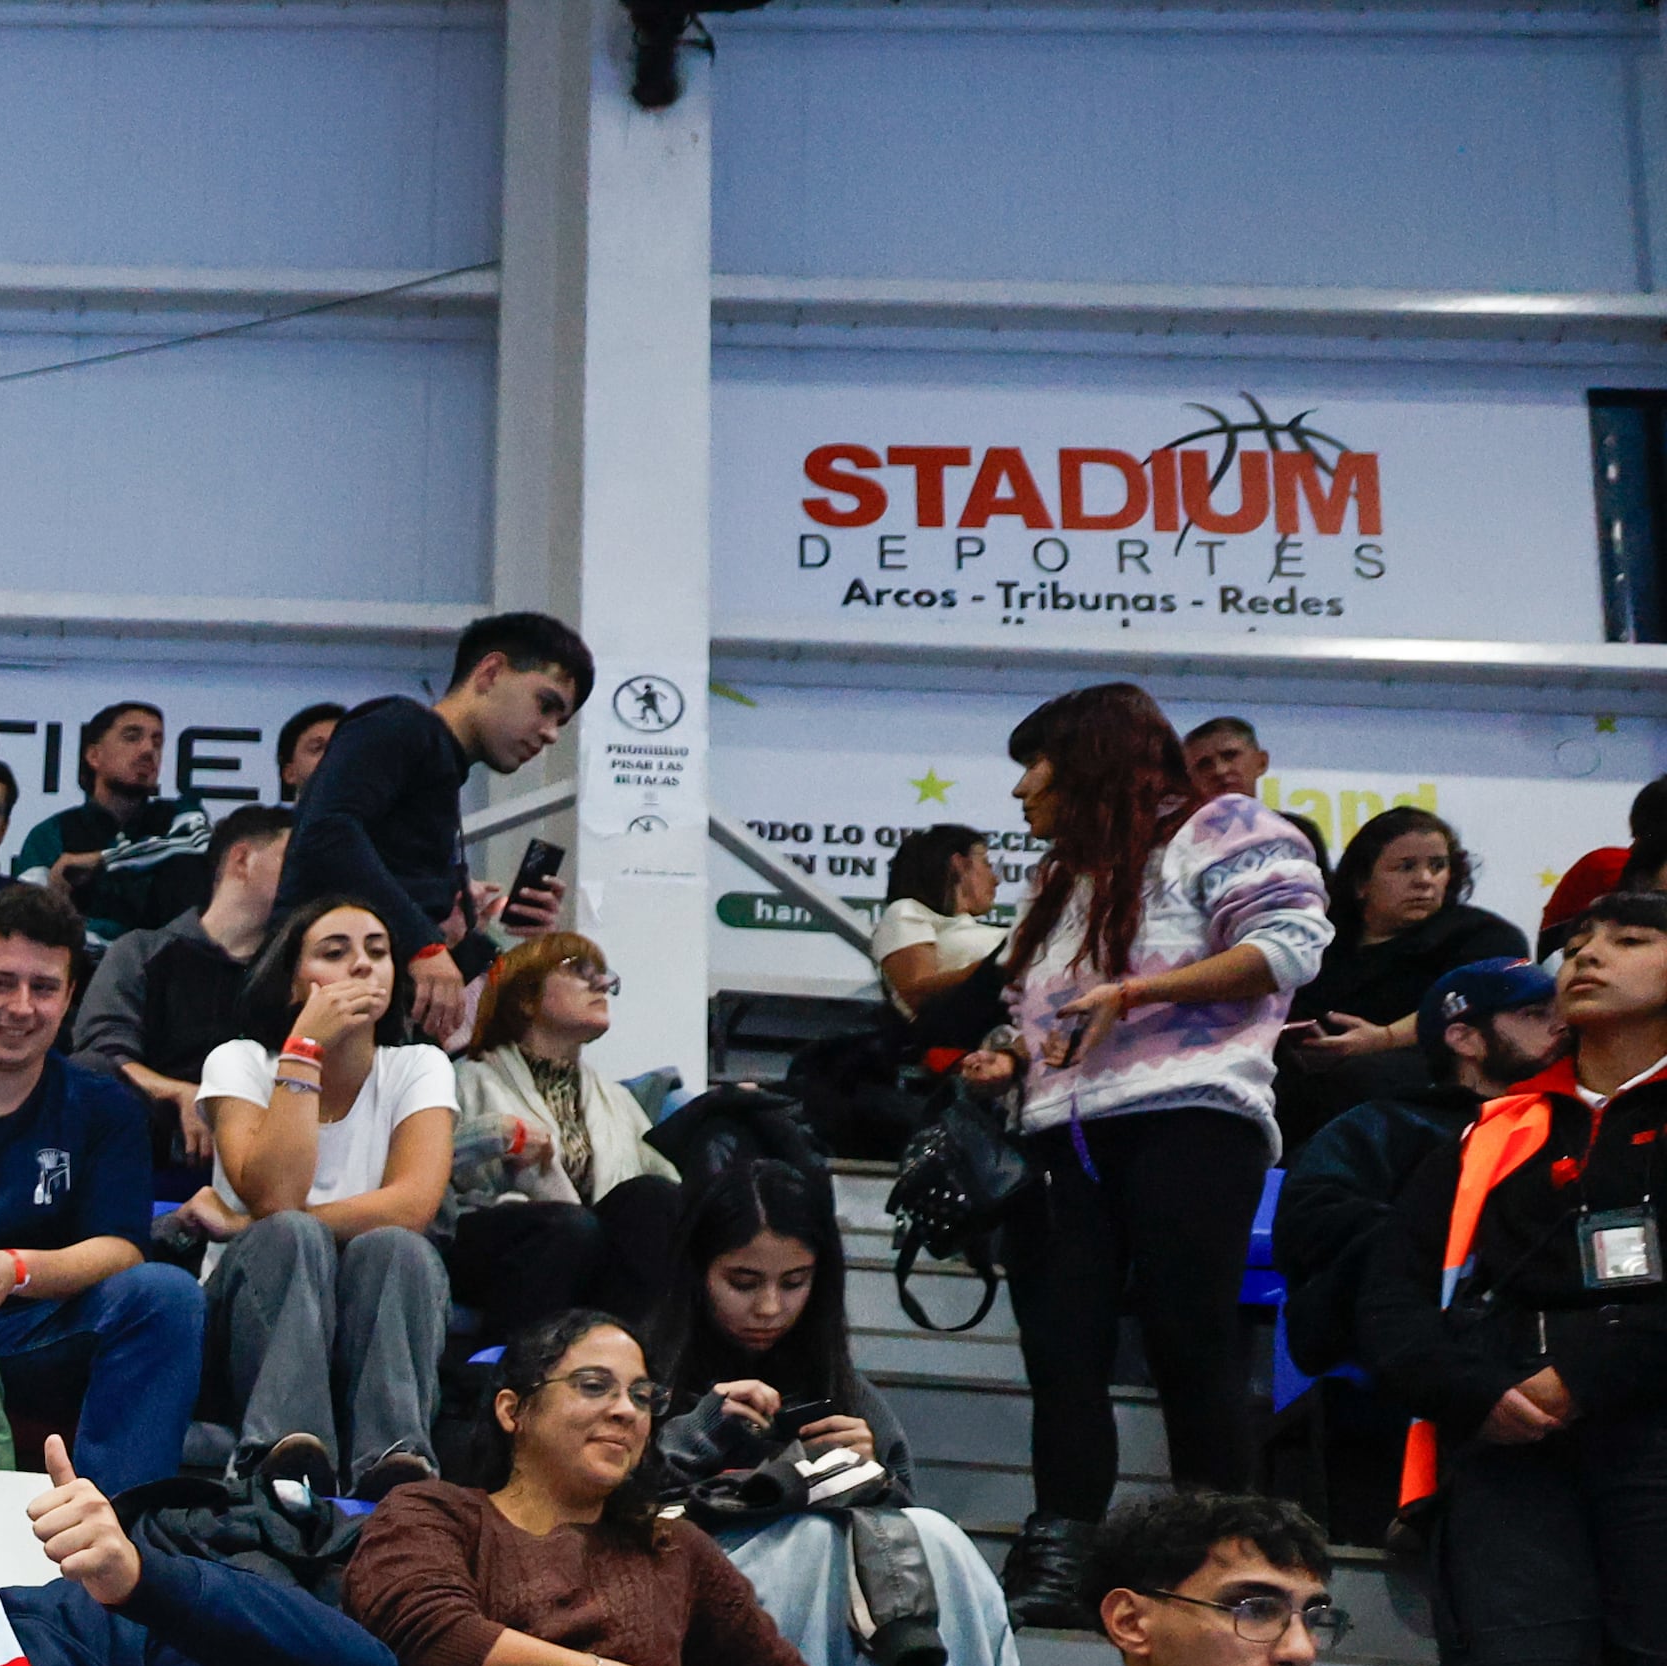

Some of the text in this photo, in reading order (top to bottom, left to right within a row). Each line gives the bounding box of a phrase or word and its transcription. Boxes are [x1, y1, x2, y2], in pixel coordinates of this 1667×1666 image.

[801, 443, 1383, 536] STADIUM
[798, 533, 1387, 581] DEPORTES
[842, 577, 958, 608] Arcos
[995, 580, 1178, 614] Tribunas
[1220, 586, 1345, 617] Redes
[610, 758, 684, 772] PISAR LAS
[743, 820, 814, 843] ODO
[823, 823, 865, 846] LO
[827, 855, 877, 877] UN
